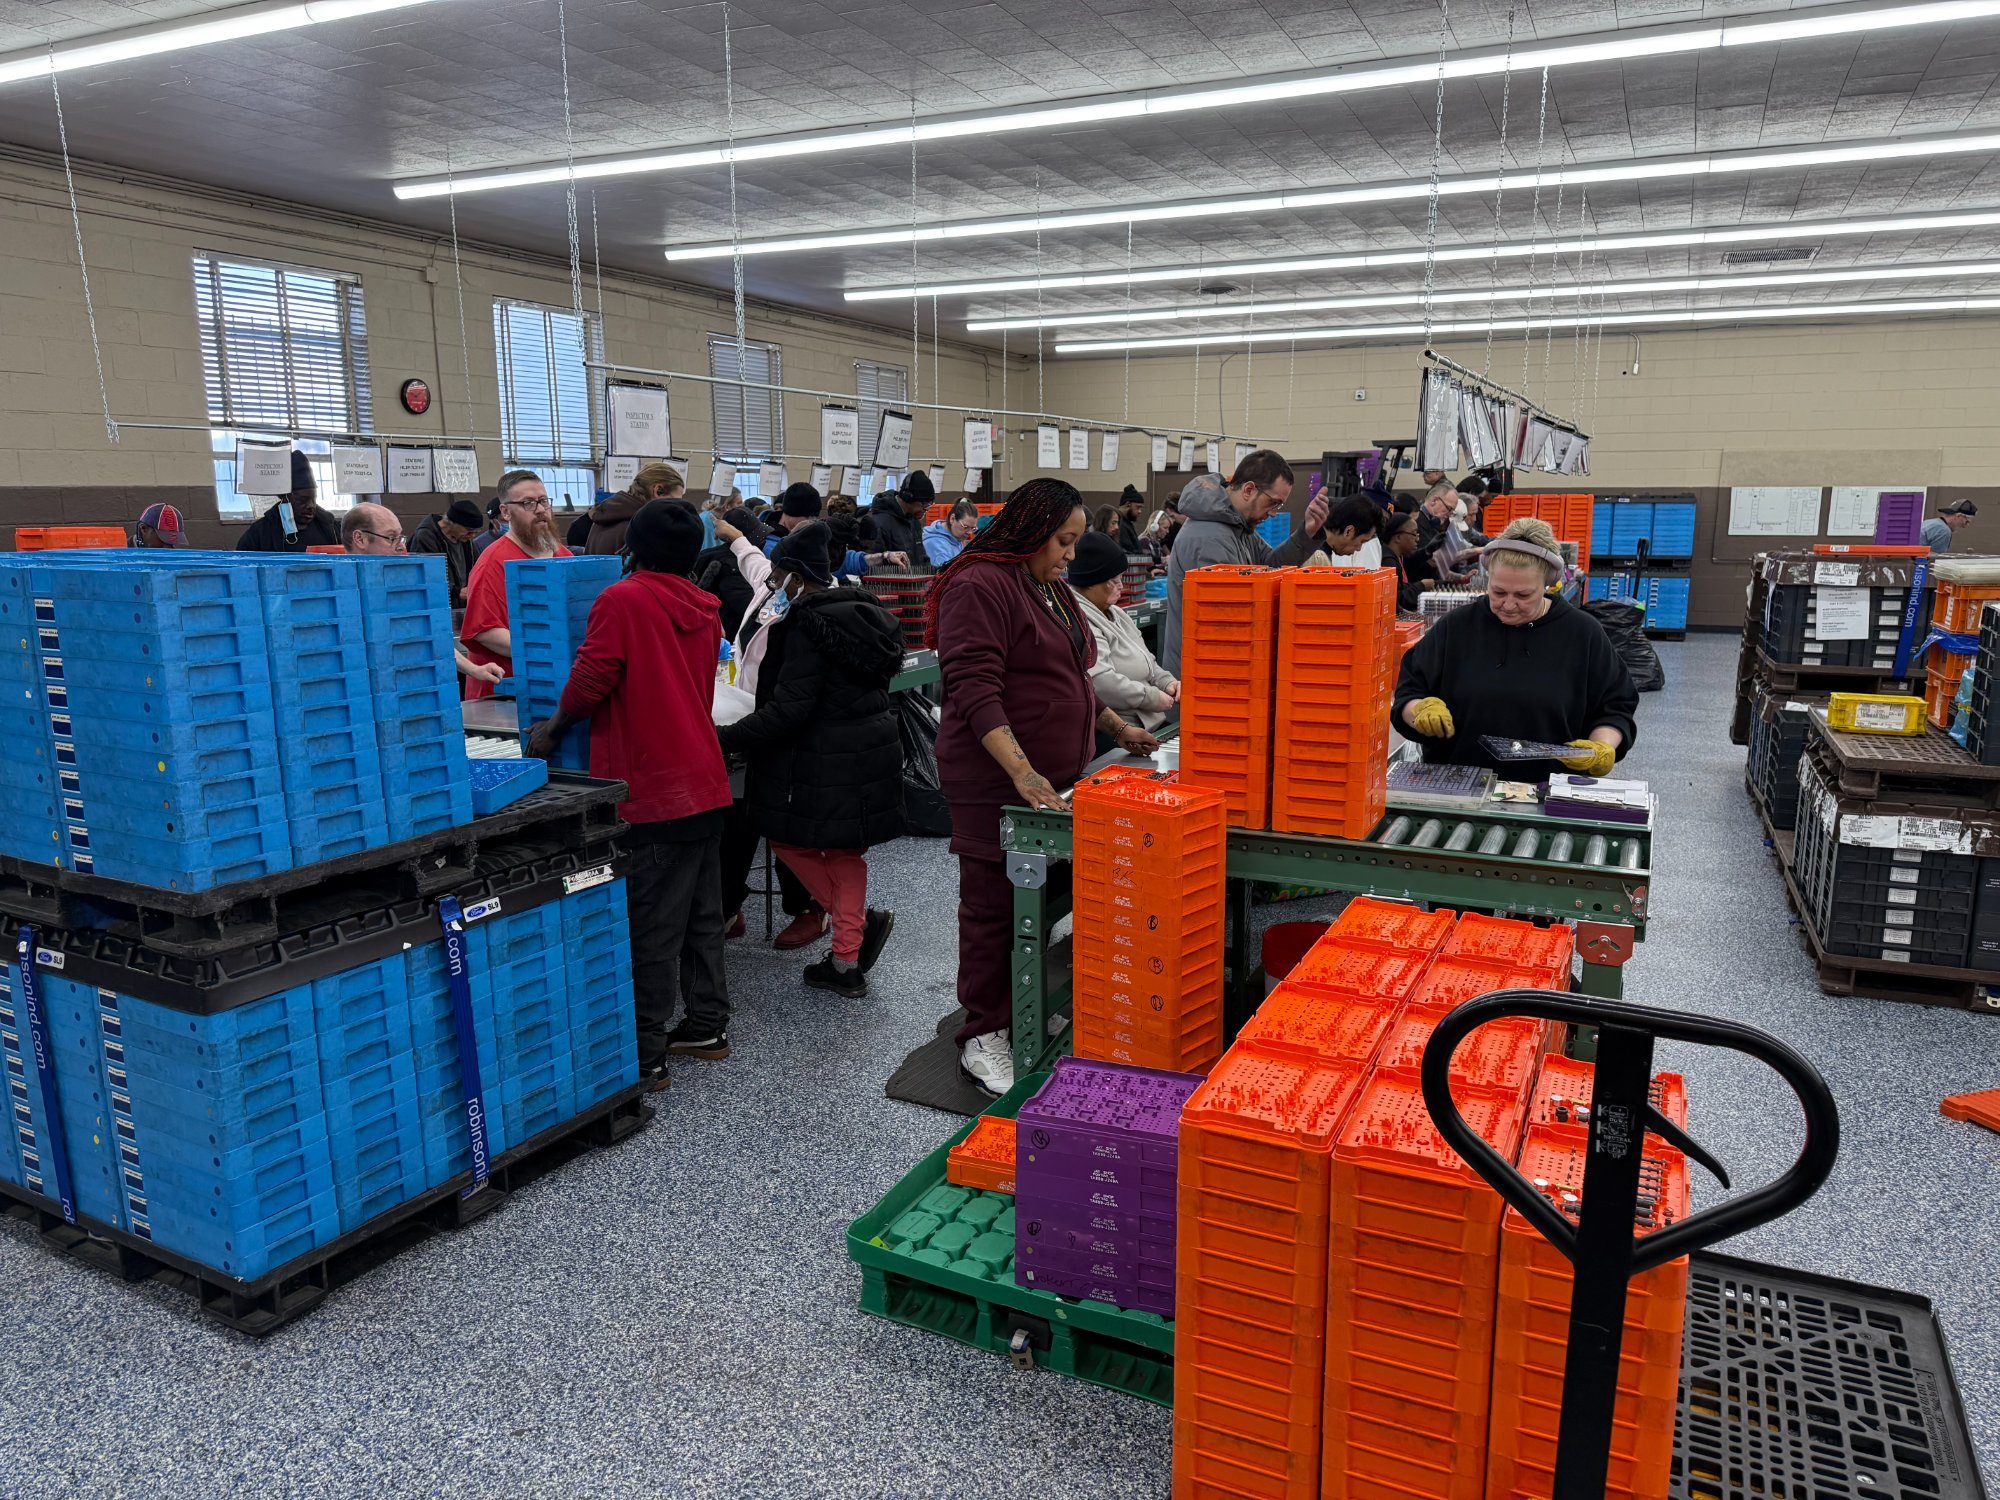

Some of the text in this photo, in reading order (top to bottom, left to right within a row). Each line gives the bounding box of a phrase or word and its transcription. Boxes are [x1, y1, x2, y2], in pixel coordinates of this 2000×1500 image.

[630, 421, 649, 429] STATION
[488, 902, 499, 911] SL9
[53, 955, 63, 969] SL9
